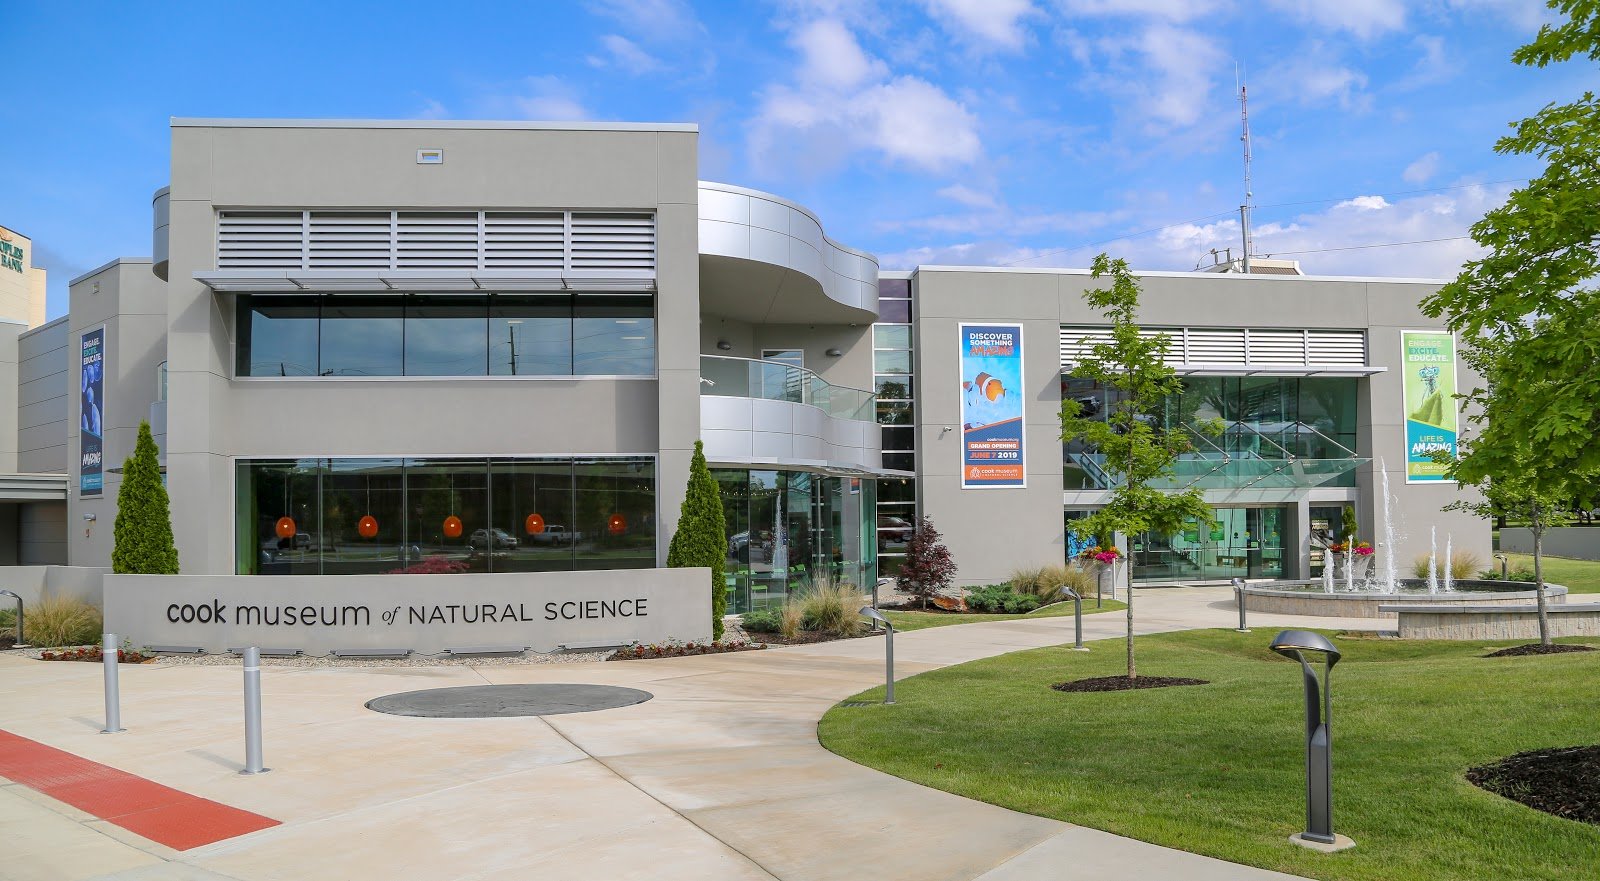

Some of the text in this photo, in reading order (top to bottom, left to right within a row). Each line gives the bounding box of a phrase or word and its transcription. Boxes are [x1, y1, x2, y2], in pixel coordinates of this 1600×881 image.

[1, 254, 23, 273] BANK
[970, 346, 1013, 356] AMAZING
[1411, 442, 1452, 454] AMAZING
[167, 599, 648, 626] cook museum of NATURAL SCIENCE
